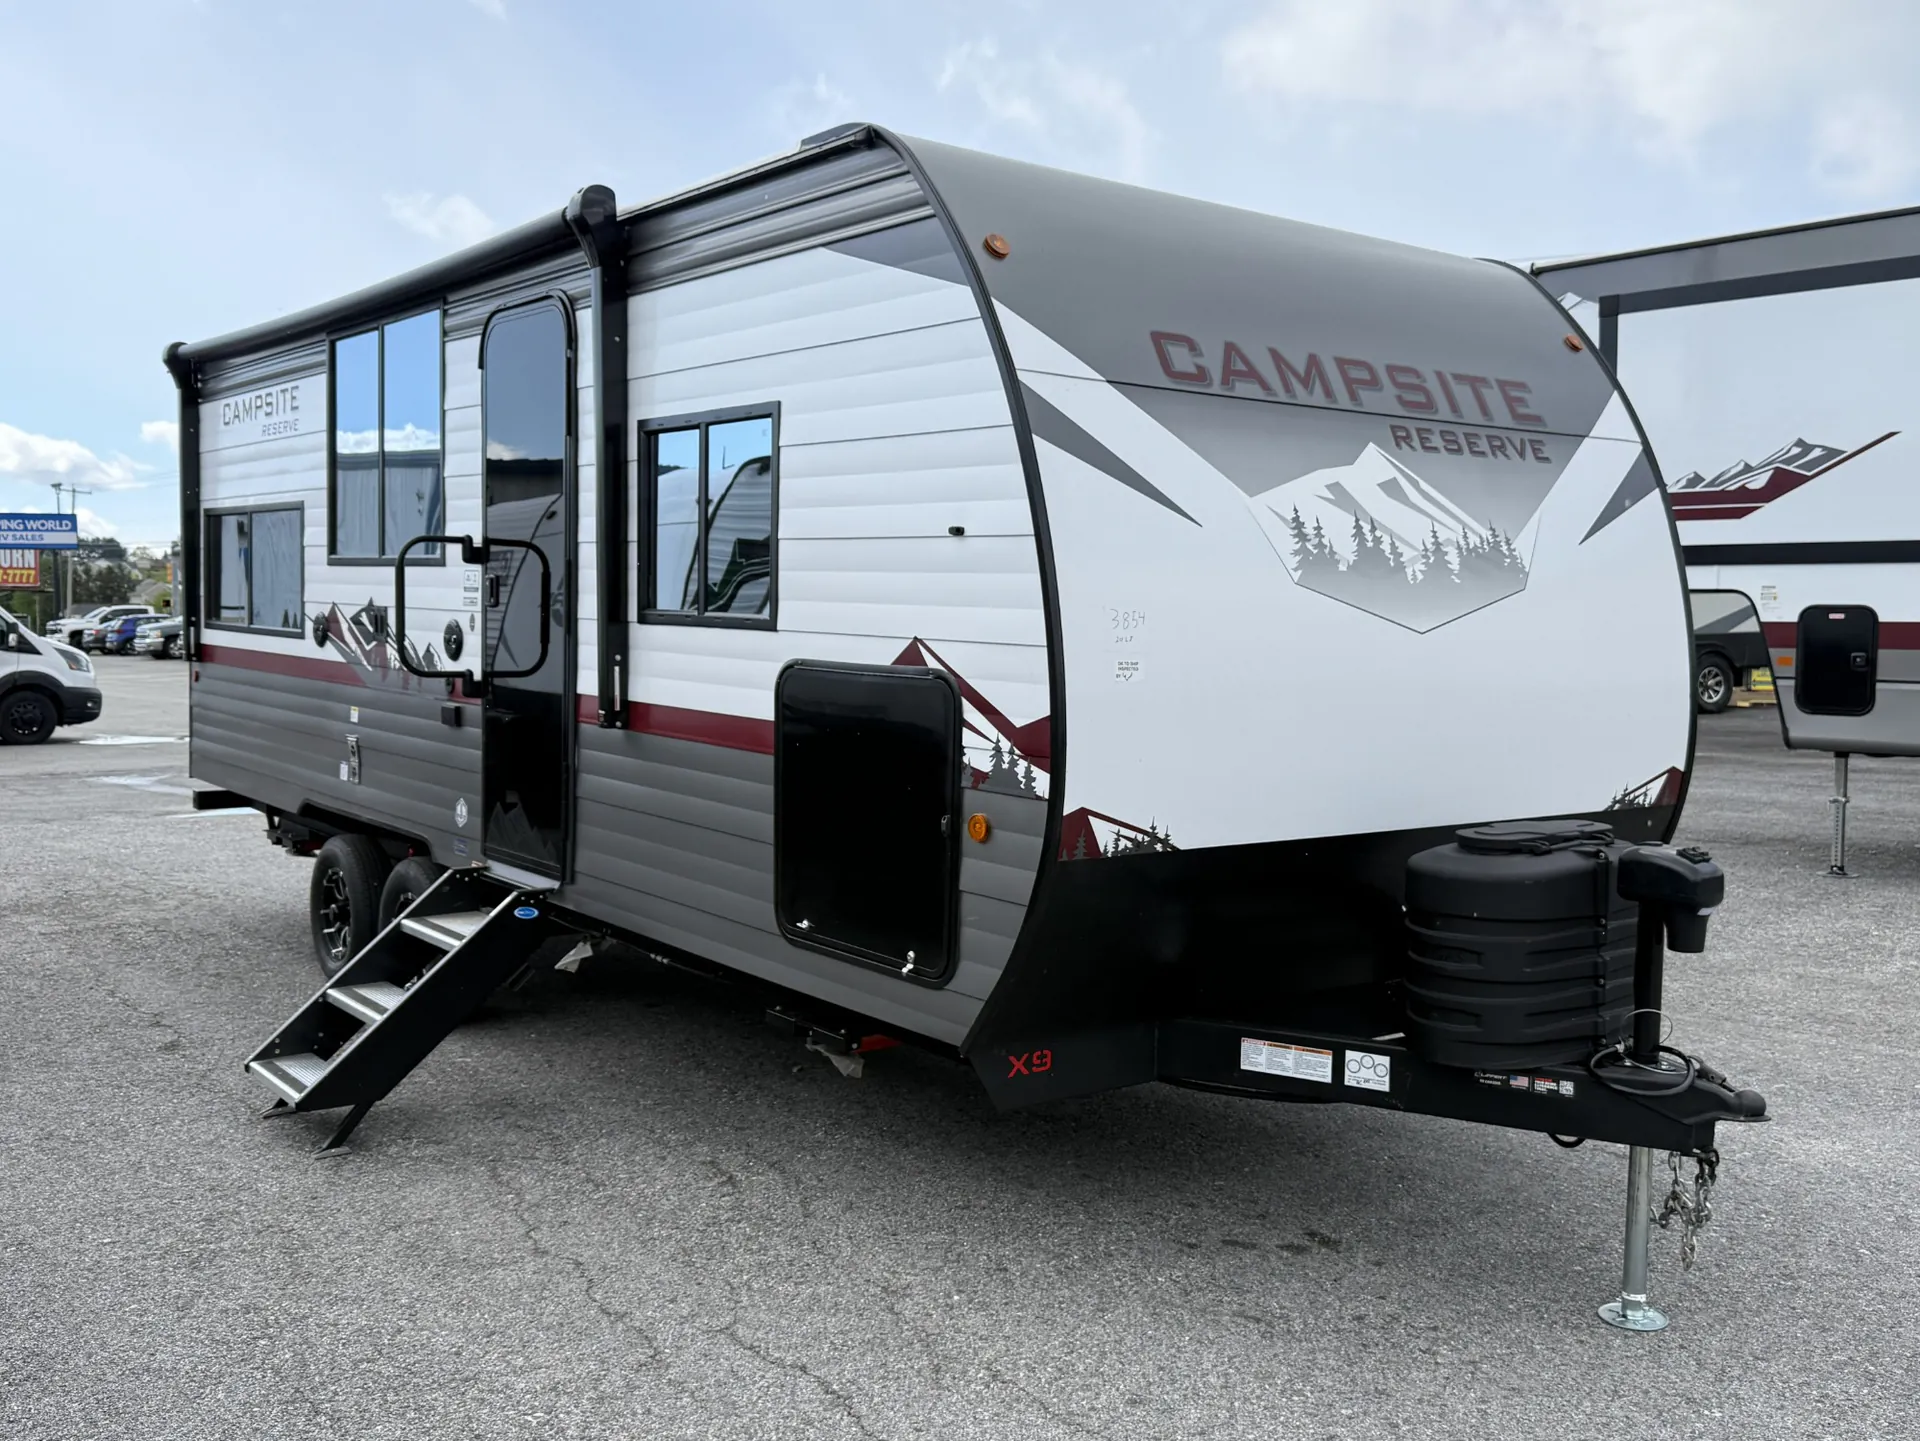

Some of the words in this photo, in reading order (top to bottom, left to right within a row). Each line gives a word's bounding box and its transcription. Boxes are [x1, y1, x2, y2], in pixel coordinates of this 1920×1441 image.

[1149, 330, 1548, 428] CAMPSITE
[223, 385, 299, 426] CAMPSITE
[262, 418, 299, 436] RESERVE
[1389, 424, 1552, 464] RESERVE
[12, 533, 44, 541] SALES
[25, 519, 72, 530] WORLD
[1110, 608, 1145, 630] 3854
[1008, 1050, 1052, 1079] X9
